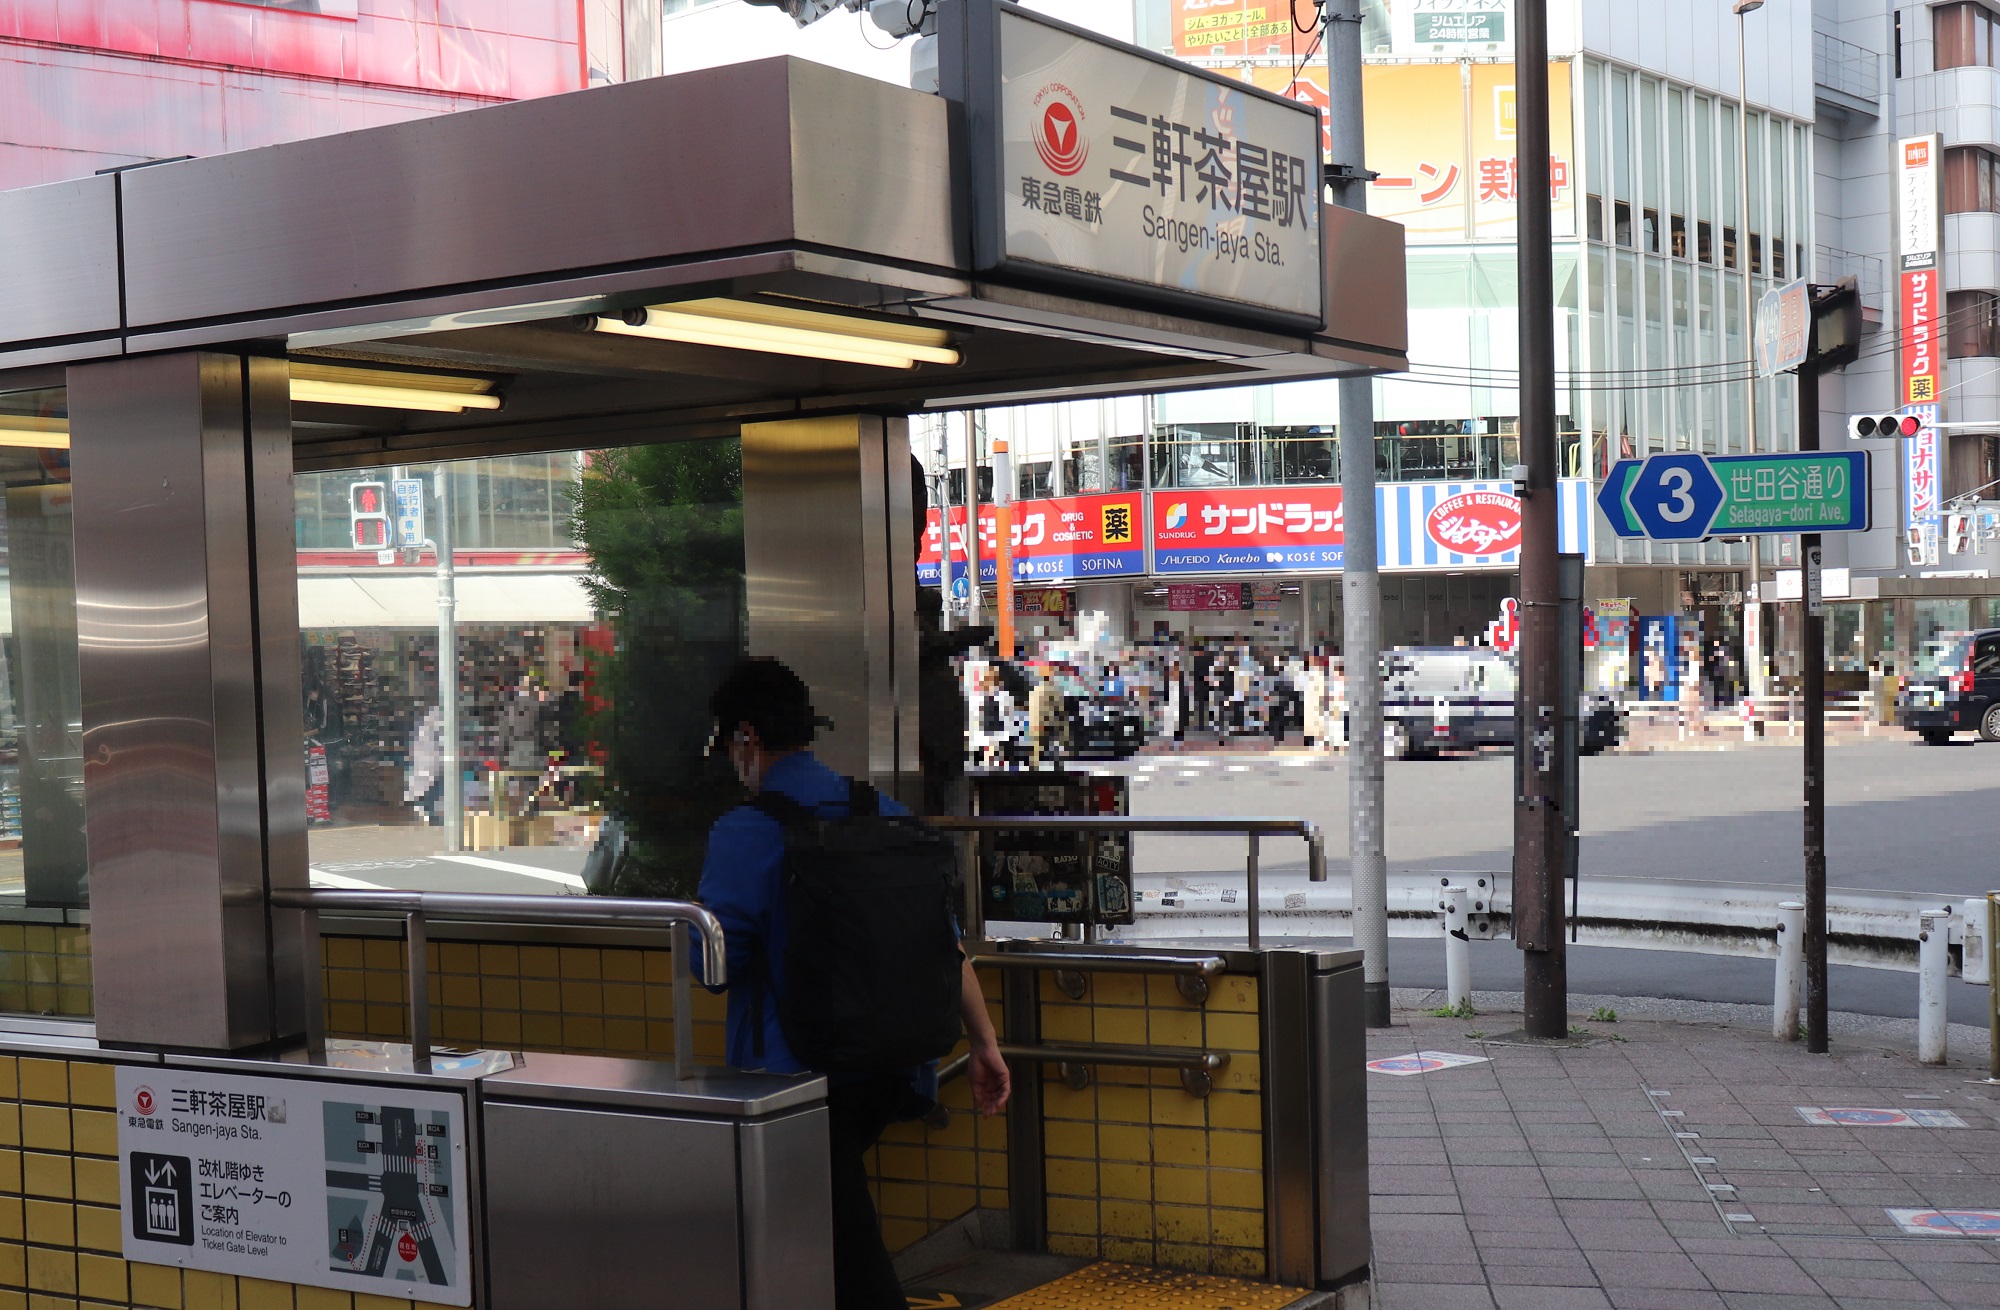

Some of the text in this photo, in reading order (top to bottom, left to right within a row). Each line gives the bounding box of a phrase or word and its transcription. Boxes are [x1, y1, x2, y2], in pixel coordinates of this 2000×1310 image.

[1188, 22, 1288, 45] やりたいことは全部ある
[1429, 28, 1490, 39] 24時間営業
[1432, 15, 1486, 27] ジムエリア
[1033, 83, 1086, 120] TOKYU CORPORATION
[1110, 105, 1308, 231] 三軒茶屋駅
[1021, 176, 1103, 225] 東急電鉄
[1907, 173, 1919, 250] ティップネス
[1142, 205, 1285, 266] Sangen-jaya Sta.
[1764, 301, 1779, 345] 246
[1911, 273, 1930, 375] サンドラッグ
[1912, 378, 1931, 399] 薬
[1657, 467, 1695, 523] 3
[1730, 465, 1845, 502] 世田谷通り
[408, 484, 419, 517] 歩行者
[1433, 497, 1464, 520] COFFEE
[1466, 495, 1473, 506] &
[1061, 512, 1084, 522] DRUG
[1105, 508, 1129, 540] 薬
[1729, 502, 1845, 526] Setagaya-dori Ave.
[1053, 531, 1093, 542] COSMETIC
[1158, 532, 1196, 540] SUNDRUG
[1436, 516, 1521, 553] ジョナサン
[1037, 560, 1064, 573] KOSÉ
[1082, 558, 1123, 571] SOFINA
[1160, 550, 1343, 565] SHISEIDO Kanebo KOSÉ SOF
[171, 1089, 266, 1121] 三軒茶屋駅
[128, 1116, 164, 1131] 東急電鉄
[172, 1118, 262, 1140] Sangen-jaya Sta.
[198, 1158, 264, 1183] 改札階ゆき
[200, 1183, 291, 1208] エレベーターの
[201, 1204, 239, 1225] ご案内
[201, 1225, 287, 1246] Location of Elevator to
[202, 1238, 268, 1256] Ticket Gate Level
